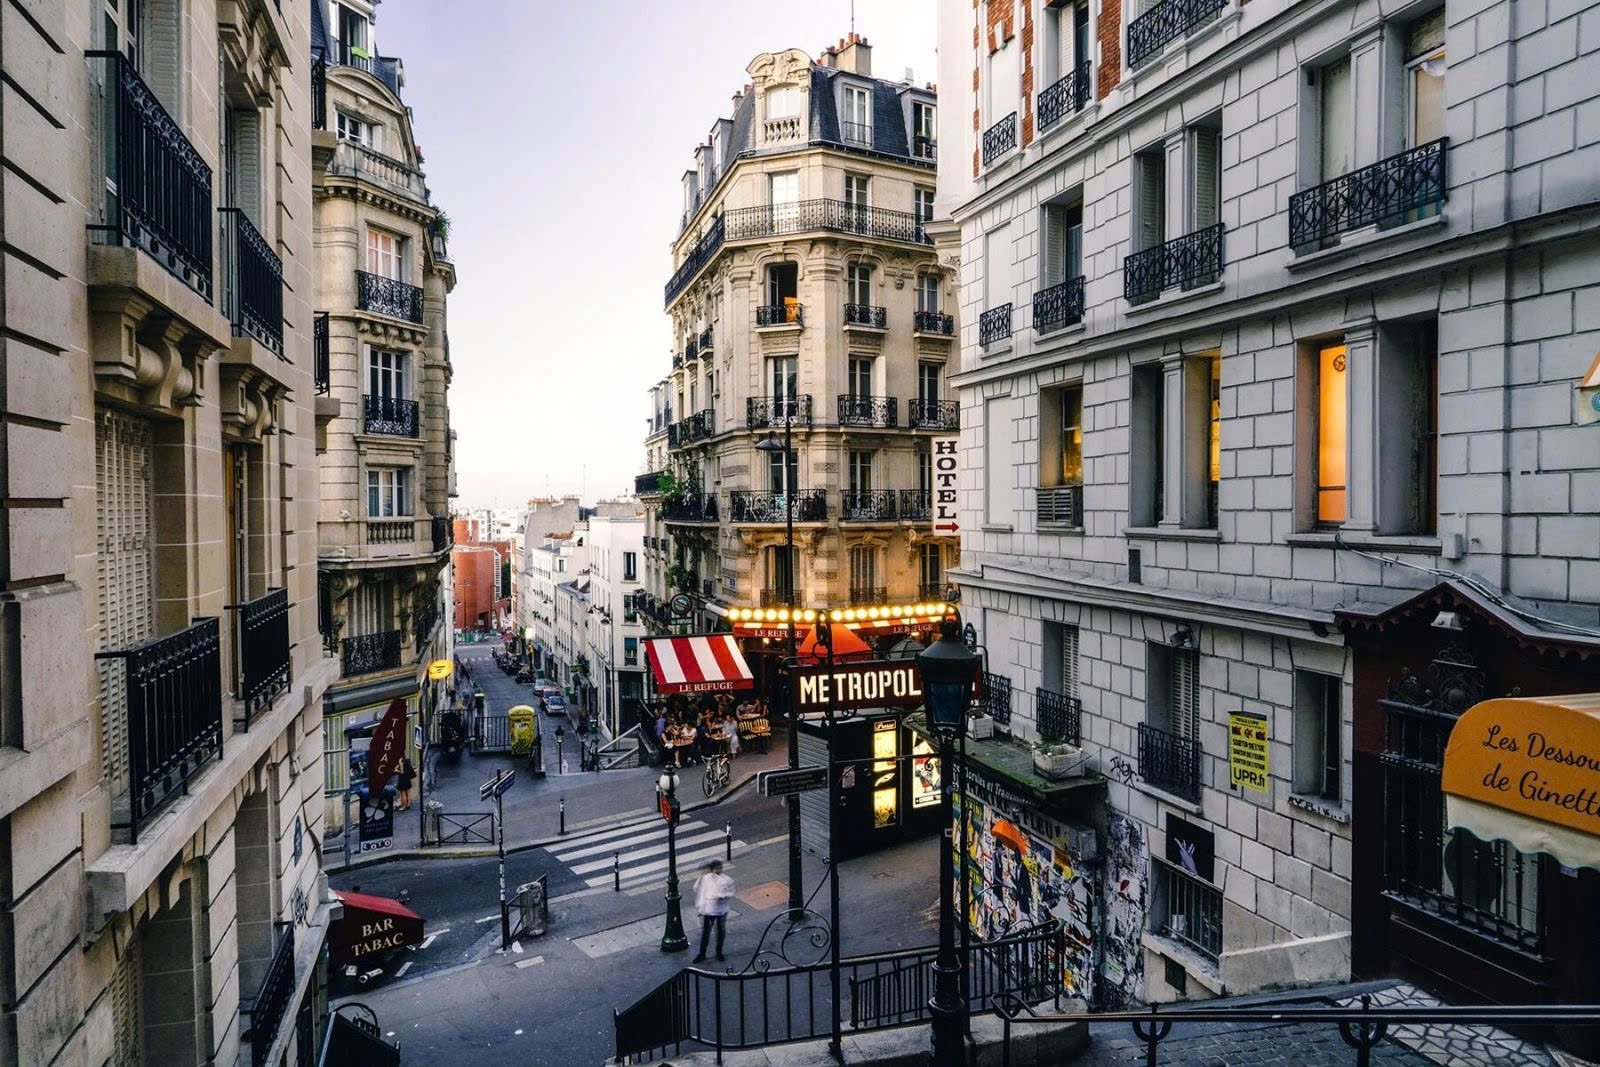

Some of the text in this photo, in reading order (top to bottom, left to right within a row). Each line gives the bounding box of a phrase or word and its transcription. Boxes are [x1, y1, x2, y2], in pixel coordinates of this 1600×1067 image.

[935, 441, 957, 519] HOTEL
[755, 629, 767, 637] LE
[893, 626, 903, 634] LE
[679, 681, 734, 692] LE REFUGE
[800, 668, 922, 704] METROPOL
[377, 717, 399, 775] TABAC
[1483, 724, 1600, 771] Les Dessou
[1482, 763, 1512, 792] de
[362, 918, 394, 937] BAR
[351, 932, 404, 957] TABAC
